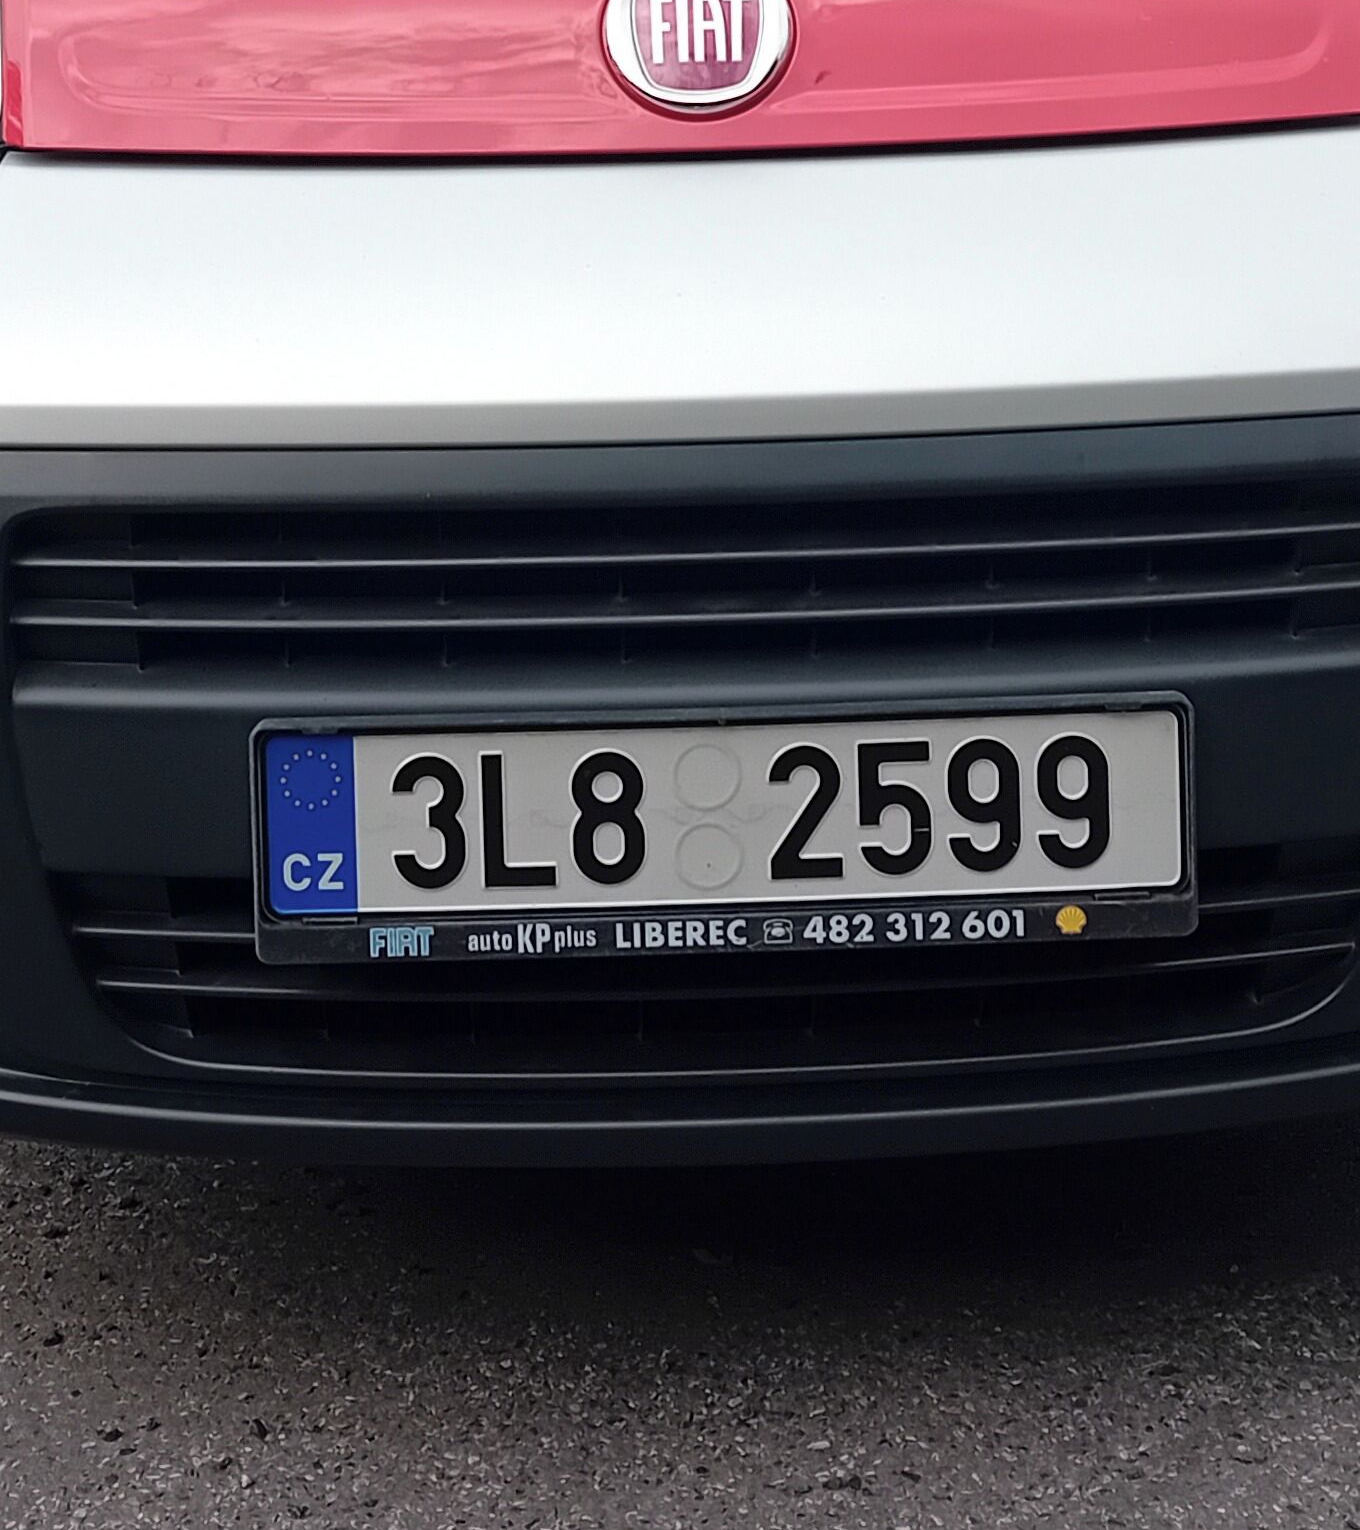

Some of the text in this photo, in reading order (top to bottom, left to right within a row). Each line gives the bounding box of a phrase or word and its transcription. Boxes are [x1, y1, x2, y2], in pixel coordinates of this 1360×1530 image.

[391, 735, 1110, 890] 3L8 2599
[282, 852, 345, 891] CZ
[369, 926, 435, 958] FIAT
[615, 918, 748, 950] LIBEREC
[802, 913, 875, 944] 482
[885, 911, 952, 942] 312
[961, 909, 1026, 938] 601
